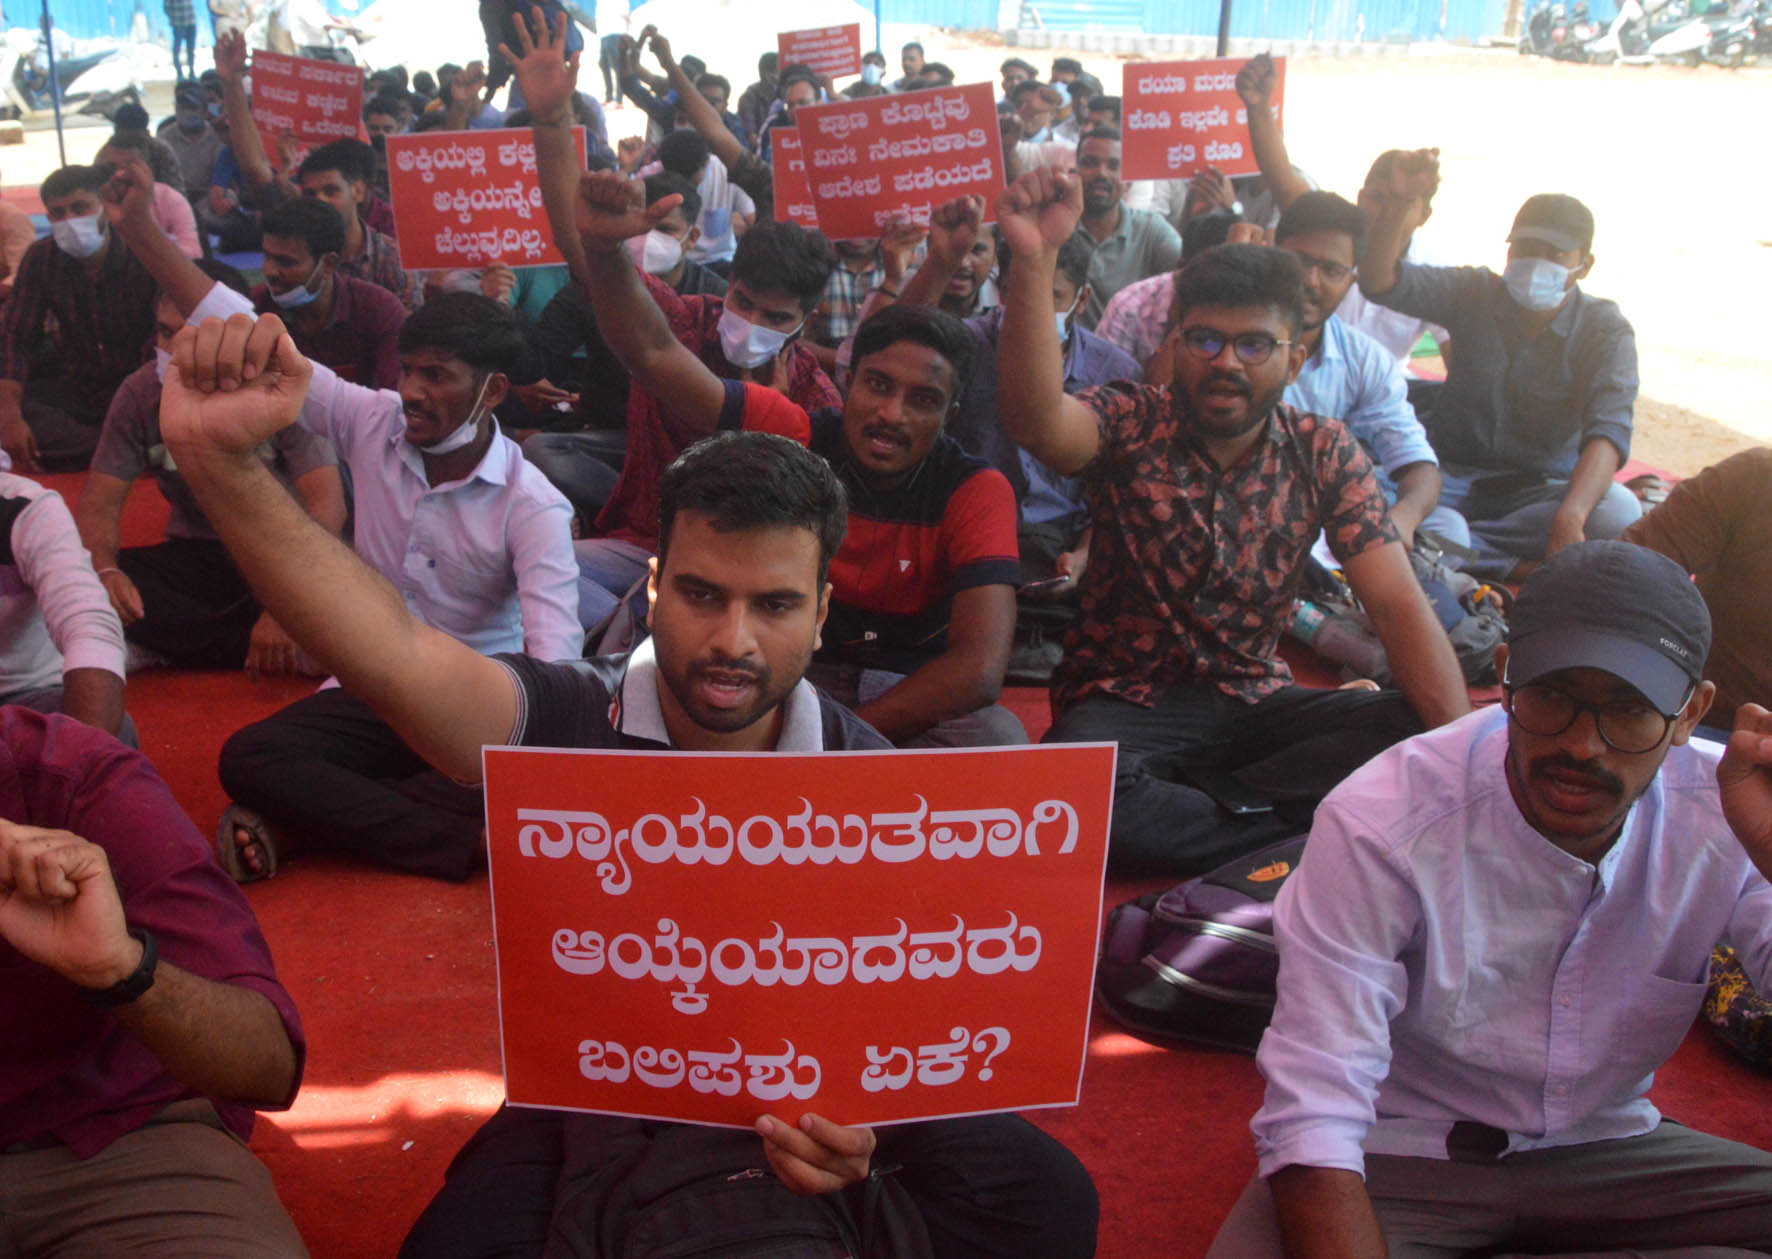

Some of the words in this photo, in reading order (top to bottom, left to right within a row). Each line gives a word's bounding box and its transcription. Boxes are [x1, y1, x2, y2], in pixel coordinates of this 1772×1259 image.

[1138, 73, 1187, 94] ದಯಾ
[818, 111, 869, 139] ಪ್ರಾಣ
[880, 93, 971, 130] ಕೊಟ್ಟೆವು
[1128, 108, 1171, 130] ಕೊಡಿ
[1179, 104, 1229, 133] ಇಲ್ಲವೇ
[396, 141, 487, 183] ಅಕ್ಕಿಯಲ್ಲಿ
[498, 138, 538, 175] ಕಲ್ಲಿ
[868, 127, 988, 161] ನೇಮಕಾತಿ
[1167, 143, 1196, 169] ಪ್ರತಿ
[1204, 139, 1243, 162] ಕೊಡಿ
[893, 157, 993, 192] ಪಡೆಯದೆ
[433, 180, 543, 225] ಅಕ್ಕಿಯನ್ನೇ
[435, 226, 547, 262] ಚೆಲ್ಲುವುದಿಲ್ಲ.
[516, 793, 1080, 896] ನ್ಯಾಯಯುತವಾಗಿ
[551, 910, 1044, 1016] ಆಯ್ಕೆಯಾದವರು
[577, 1036, 822, 1101] ಬಲಿಪಶು
[860, 1026, 1012, 1094] ಏಕೆ?
